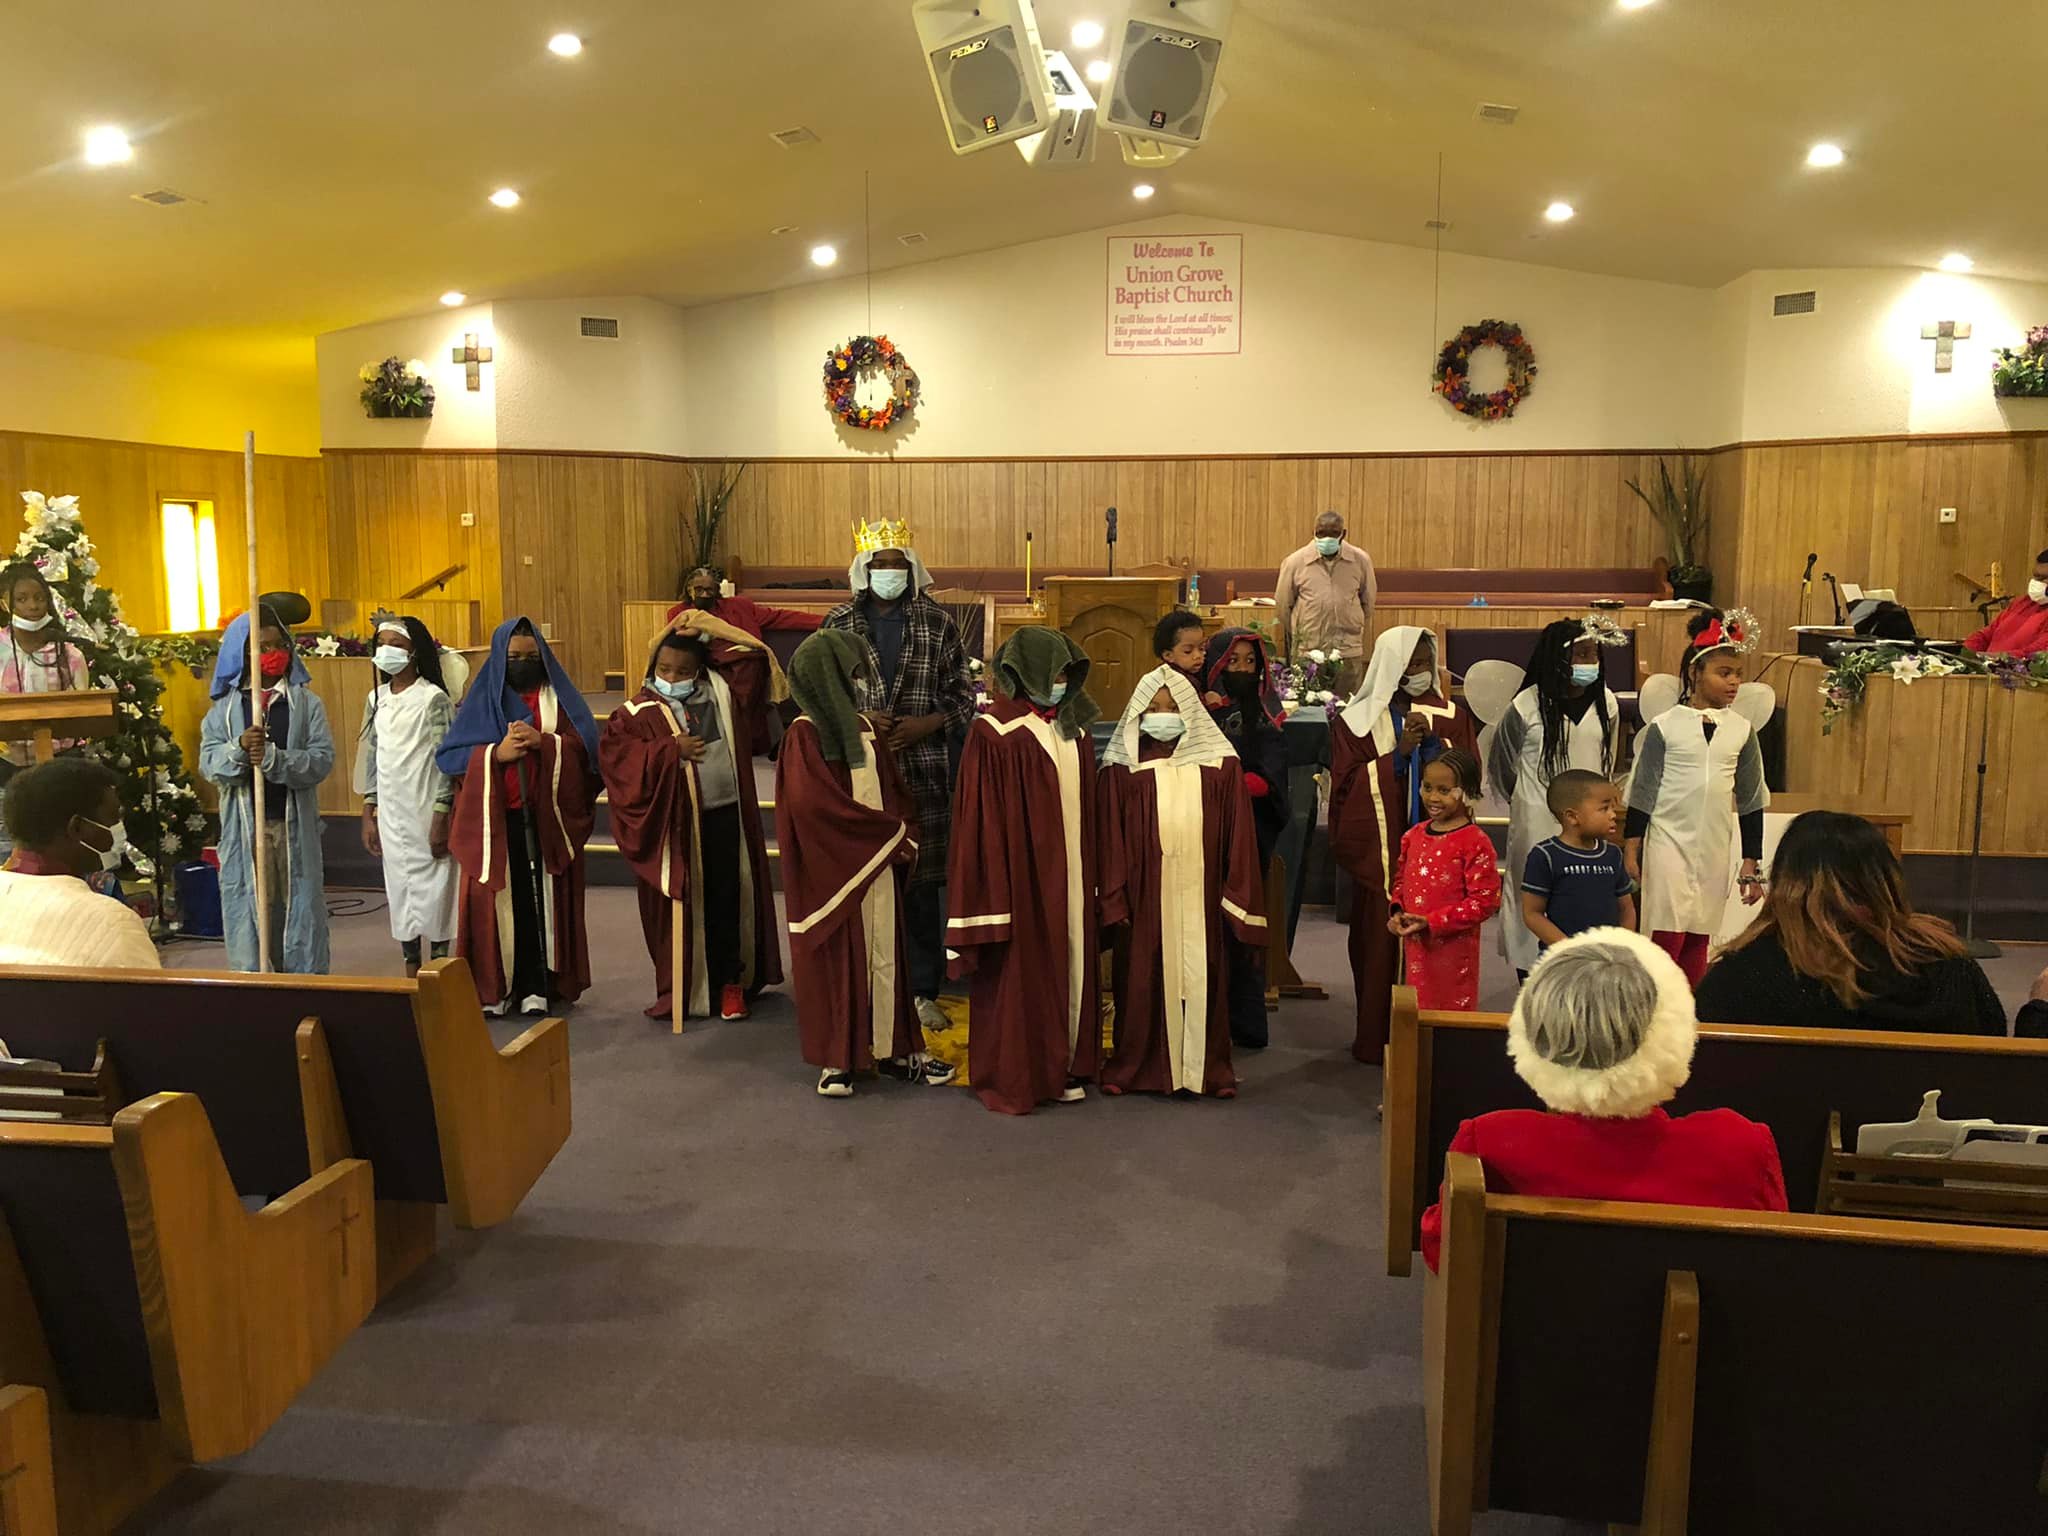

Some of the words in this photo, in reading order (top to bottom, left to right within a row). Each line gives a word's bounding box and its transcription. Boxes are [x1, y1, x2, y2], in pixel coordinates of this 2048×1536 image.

[949, 38, 990, 60] PEAVEY
[1152, 32, 1201, 49] PEAVEY
[1133, 242, 1193, 259] Welcome
[1198, 241, 1215, 257] To
[1126, 265, 1174, 284] Union
[1177, 265, 1224, 283] Grove
[1115, 286, 1170, 309] Baptist
[1173, 284, 1233, 304] Church
[1114, 315, 1119, 324] I
[1120, 315, 1136, 324] will
[1136, 314, 1155, 324] bless
[1155, 314, 1168, 323] the
[1169, 313, 1188, 323] Lord
[1188, 315, 1197, 323] at
[1198, 313, 1209, 322] all
[1114, 327, 1128, 336] His
[1129, 327, 1153, 337] praise
[1154, 325, 1172, 335] shall
[1173, 325, 1217, 336] continually
[1217, 325, 1227, 334] be
[1123, 340, 1135, 349] my
[1164, 337, 1188, 347] Psalm
